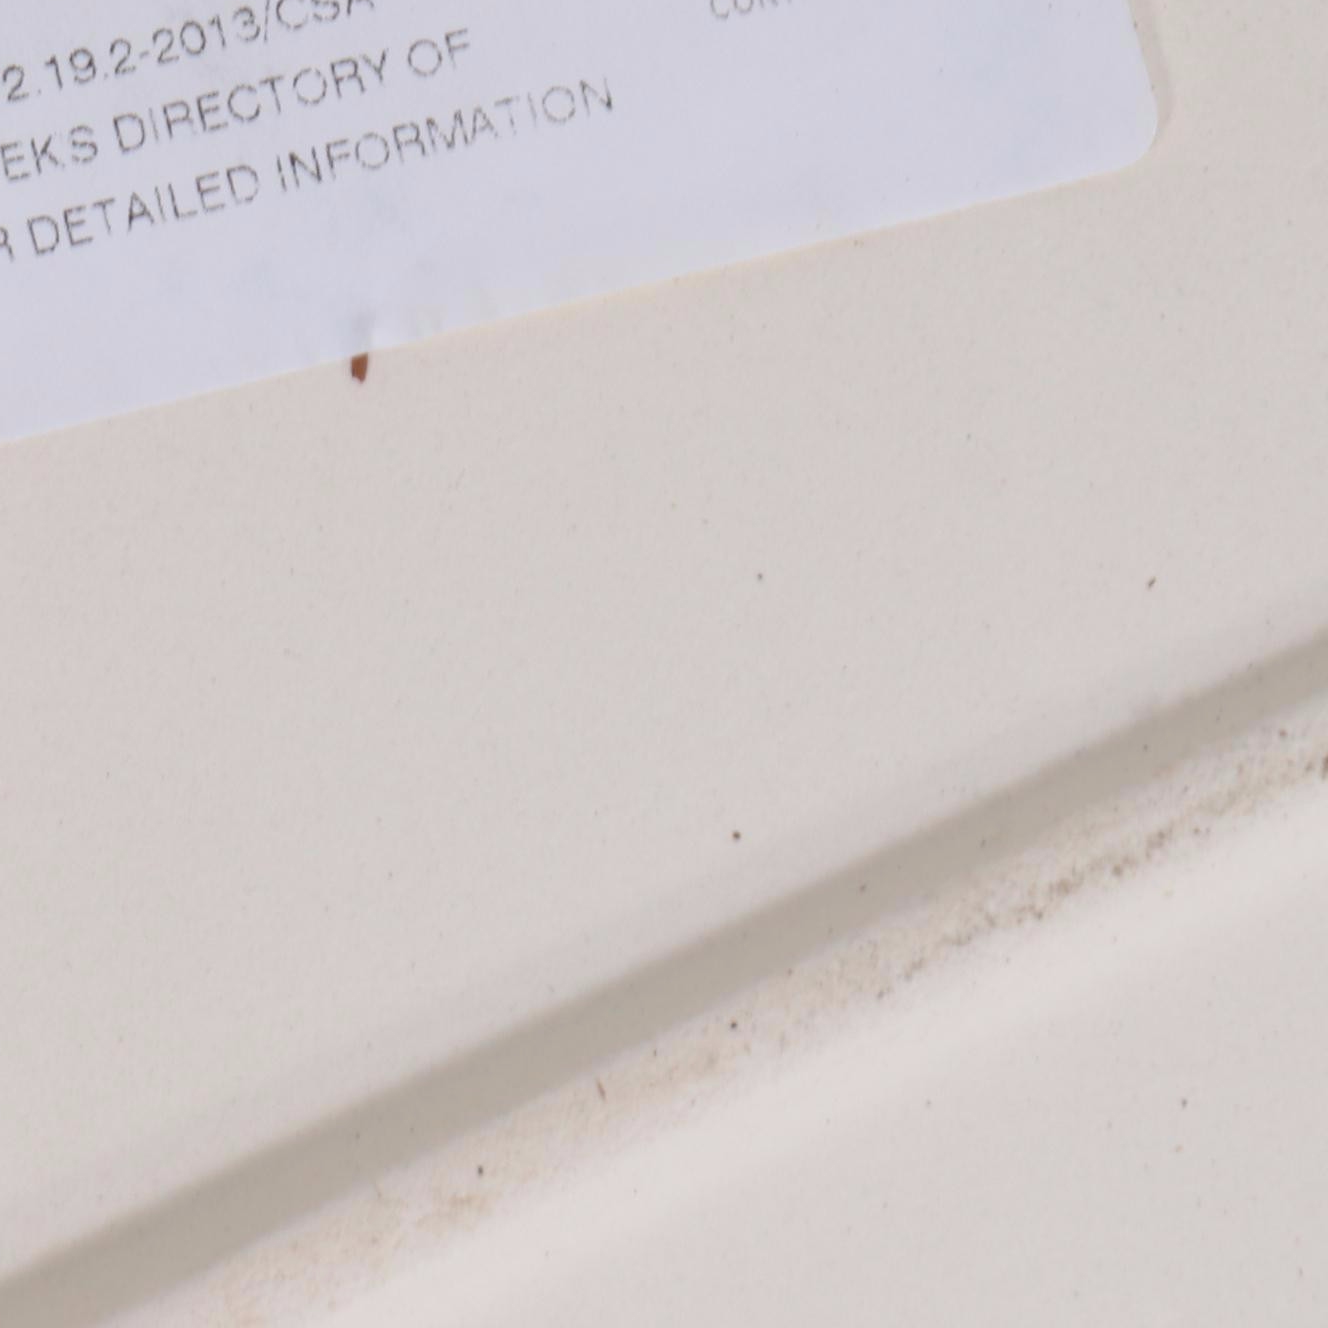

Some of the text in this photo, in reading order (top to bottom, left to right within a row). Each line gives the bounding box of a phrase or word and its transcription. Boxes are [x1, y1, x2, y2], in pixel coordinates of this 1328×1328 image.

[28, 164, 258, 256] DETAILED
[276, 76, 614, 191] INFORMATION
[113, 49, 389, 154] DIRECTORY
[407, 28, 470, 76] OF
